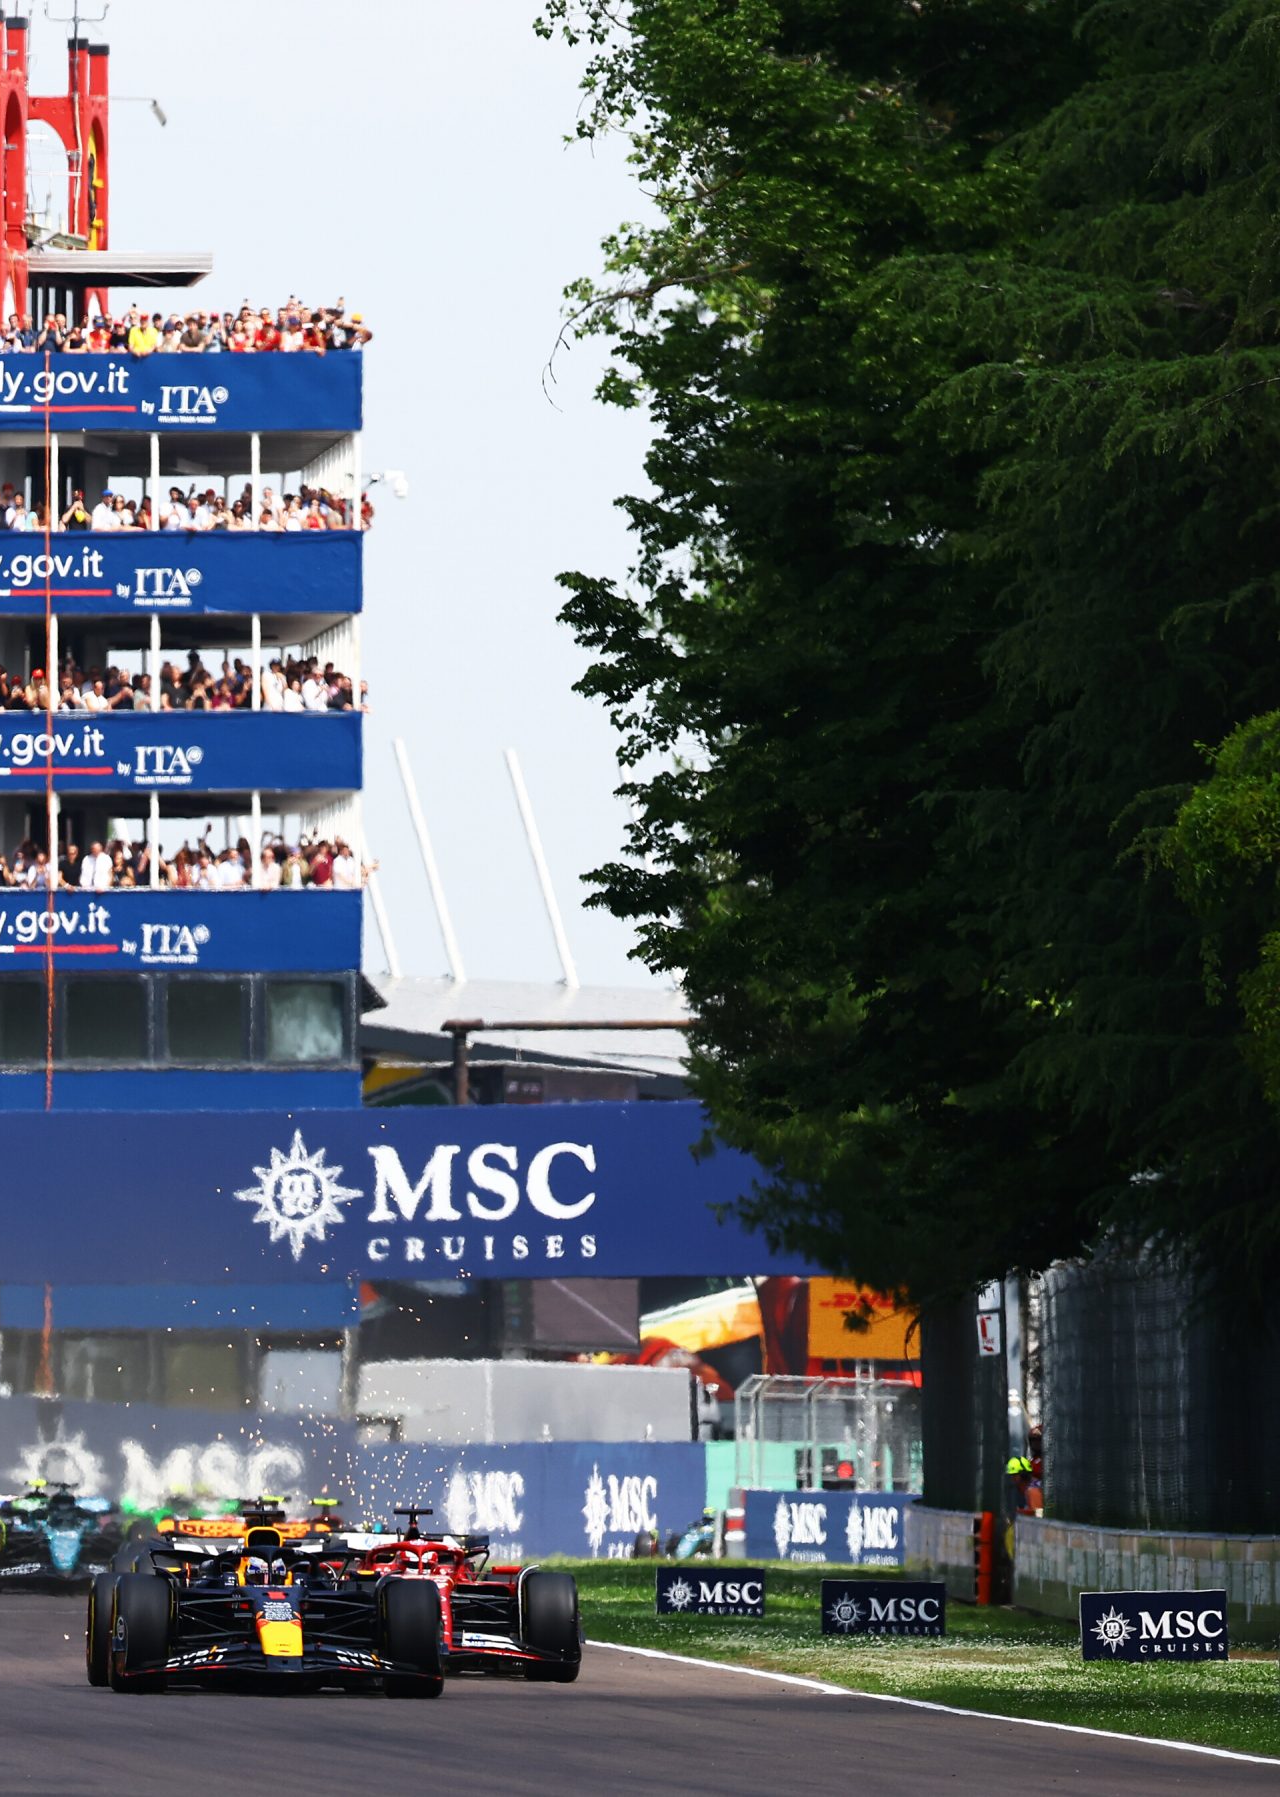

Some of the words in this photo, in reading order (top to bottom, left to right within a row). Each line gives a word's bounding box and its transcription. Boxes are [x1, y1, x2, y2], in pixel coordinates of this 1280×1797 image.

[142, 400, 154, 414] by
[158, 385, 217, 414] ITA
[116, 582, 131, 599] by
[134, 567, 192, 596] ITA
[117, 760, 131, 776] by
[134, 745, 192, 775] ITA
[122, 939, 137, 955] by
[141, 923, 198, 955] ITA
[367, 1141, 597, 1223] MSC
[367, 1235, 597, 1261] CRUISES
[608, 1474, 657, 1532] MSC
[790, 1502, 827, 1545] MSC
[863, 1505, 899, 1549] MSC
[698, 1581, 762, 1604] MSC
[868, 1597, 939, 1622] MSC
[1138, 1610, 1224, 1639] MSC
[1139, 1642, 1225, 1654] CRUISES
